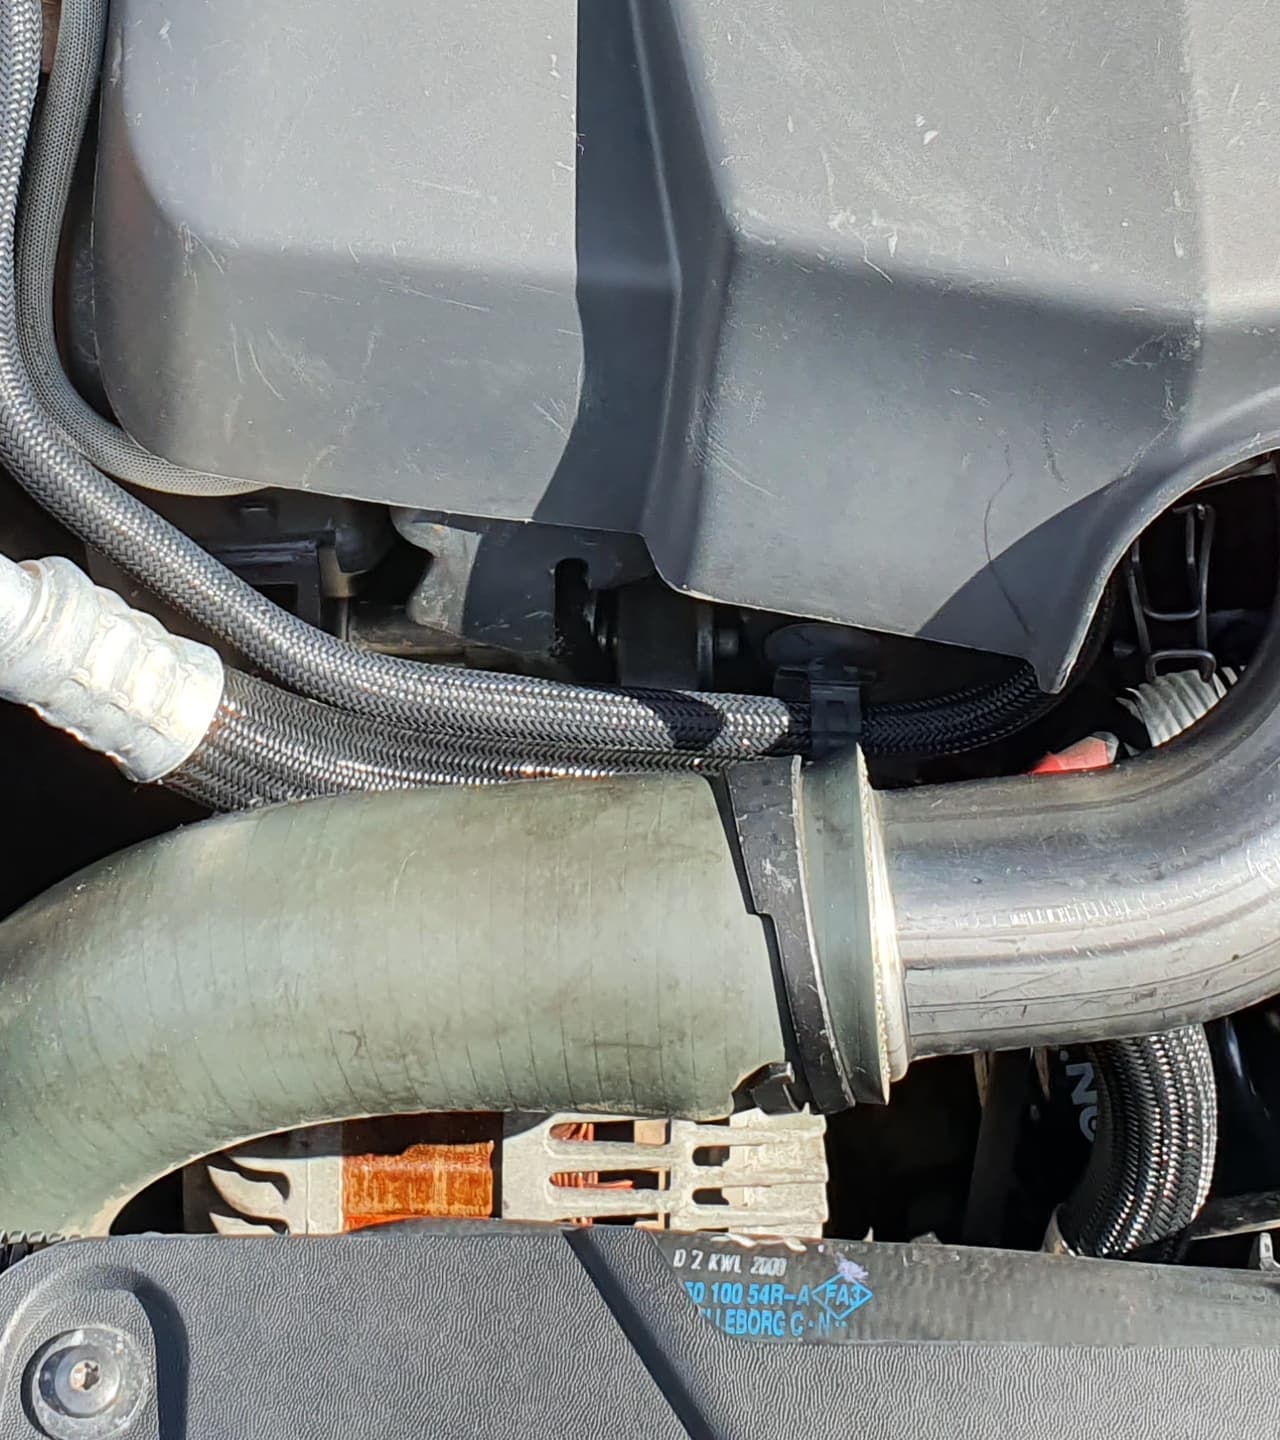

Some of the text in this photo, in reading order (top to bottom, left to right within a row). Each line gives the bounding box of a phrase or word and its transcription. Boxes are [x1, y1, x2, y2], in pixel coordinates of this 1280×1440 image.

[690, 1249, 705, 1271] 2
[711, 1281, 744, 1305] 100
[824, 1283, 862, 1307] FA3
